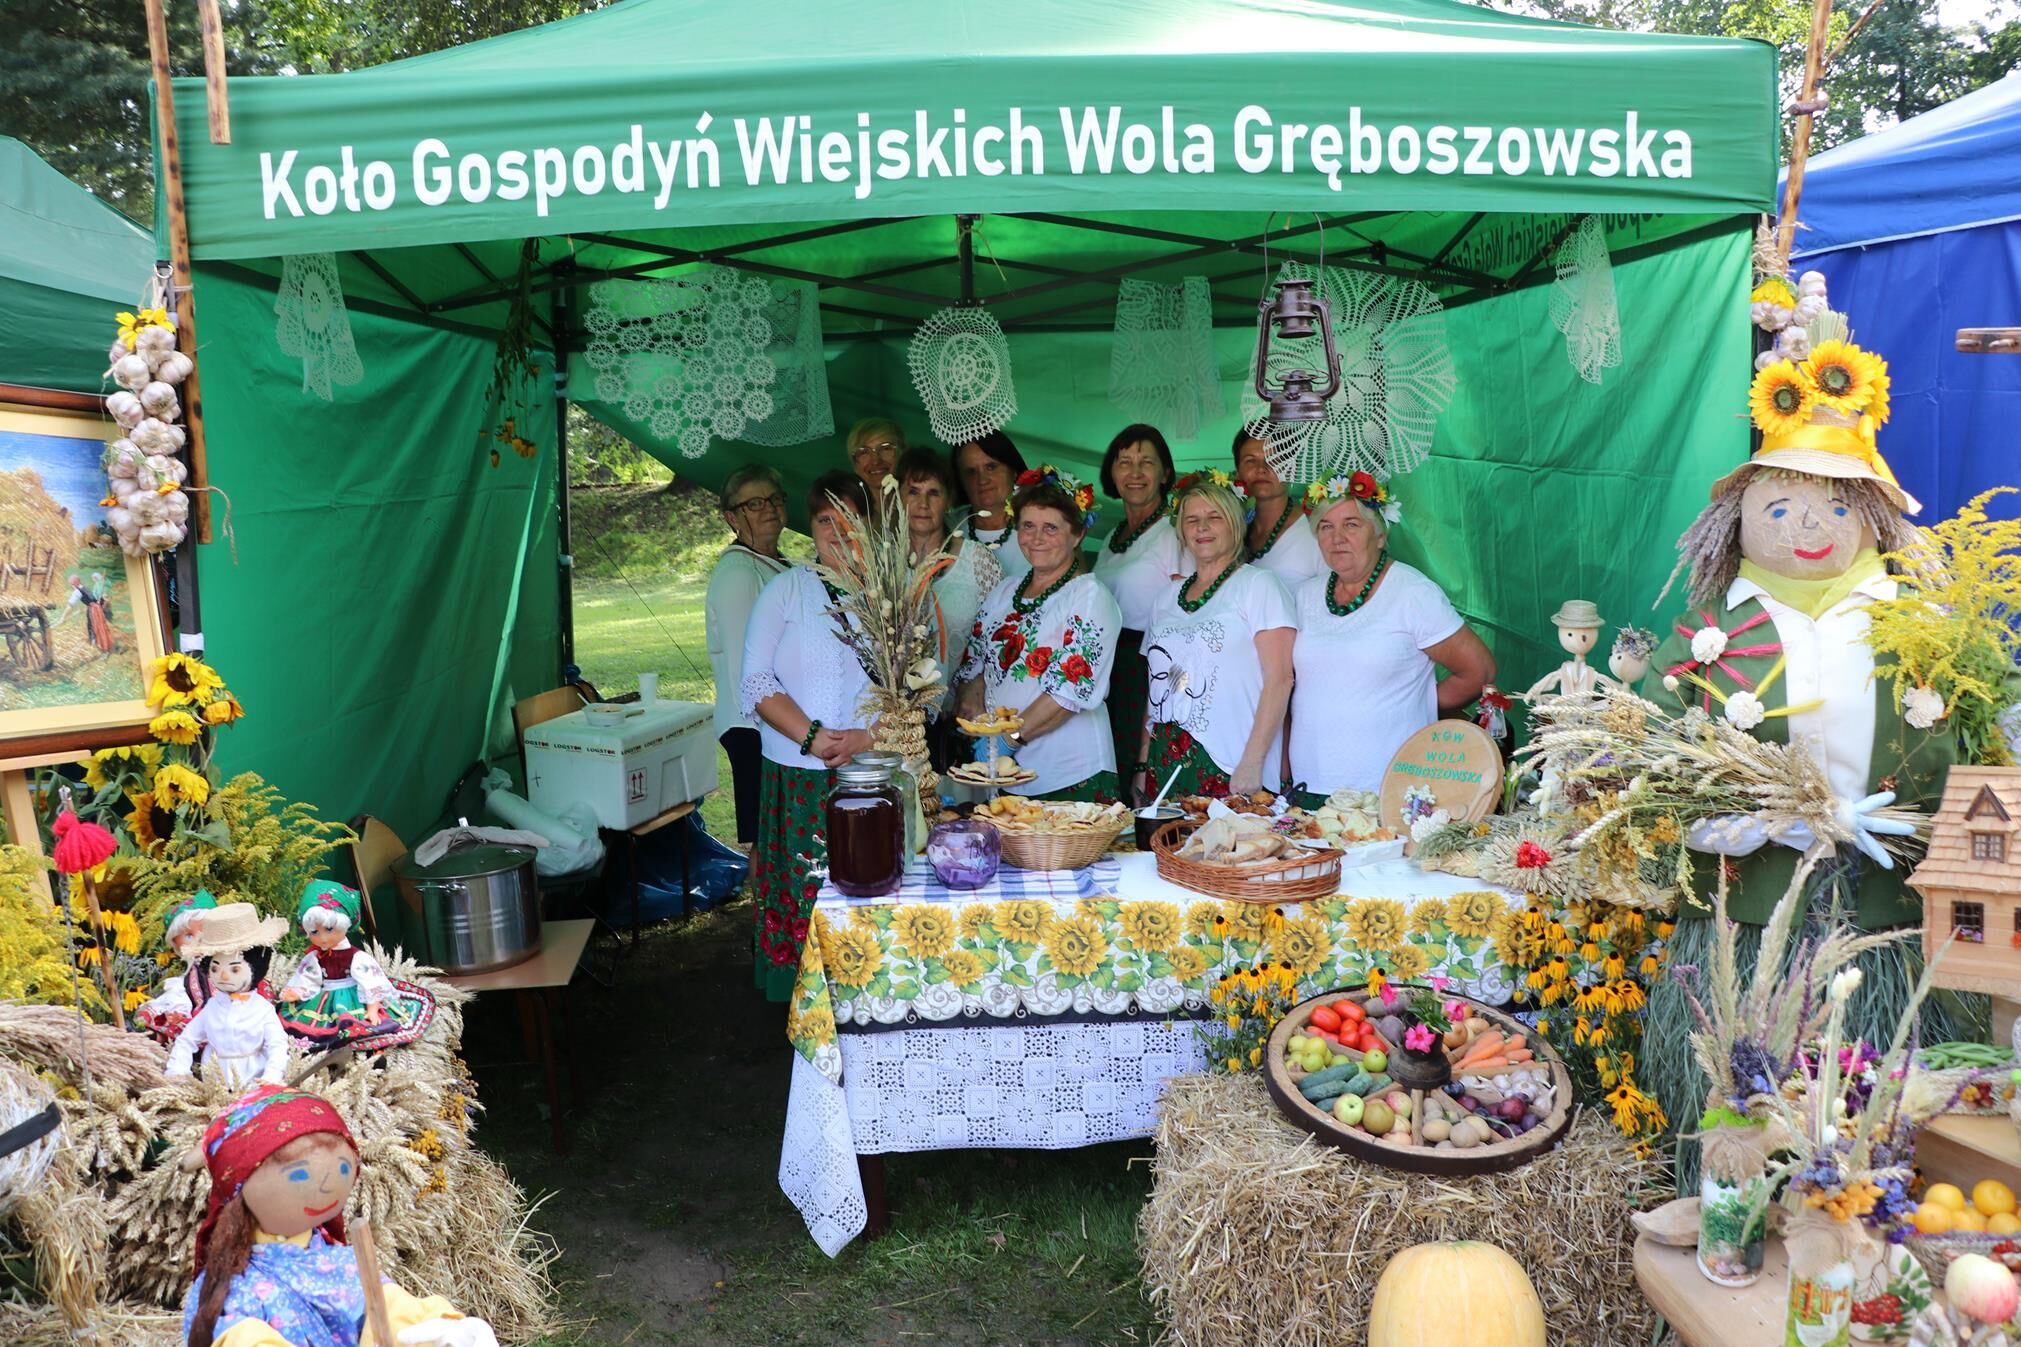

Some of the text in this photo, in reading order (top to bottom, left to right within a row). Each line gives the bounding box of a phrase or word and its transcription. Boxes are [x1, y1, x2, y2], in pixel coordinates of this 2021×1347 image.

[258, 104, 1694, 220] Koło Gospodyń Wiejskich Wola Gręboszowska
[1425, 751, 1466, 763] WOLA
